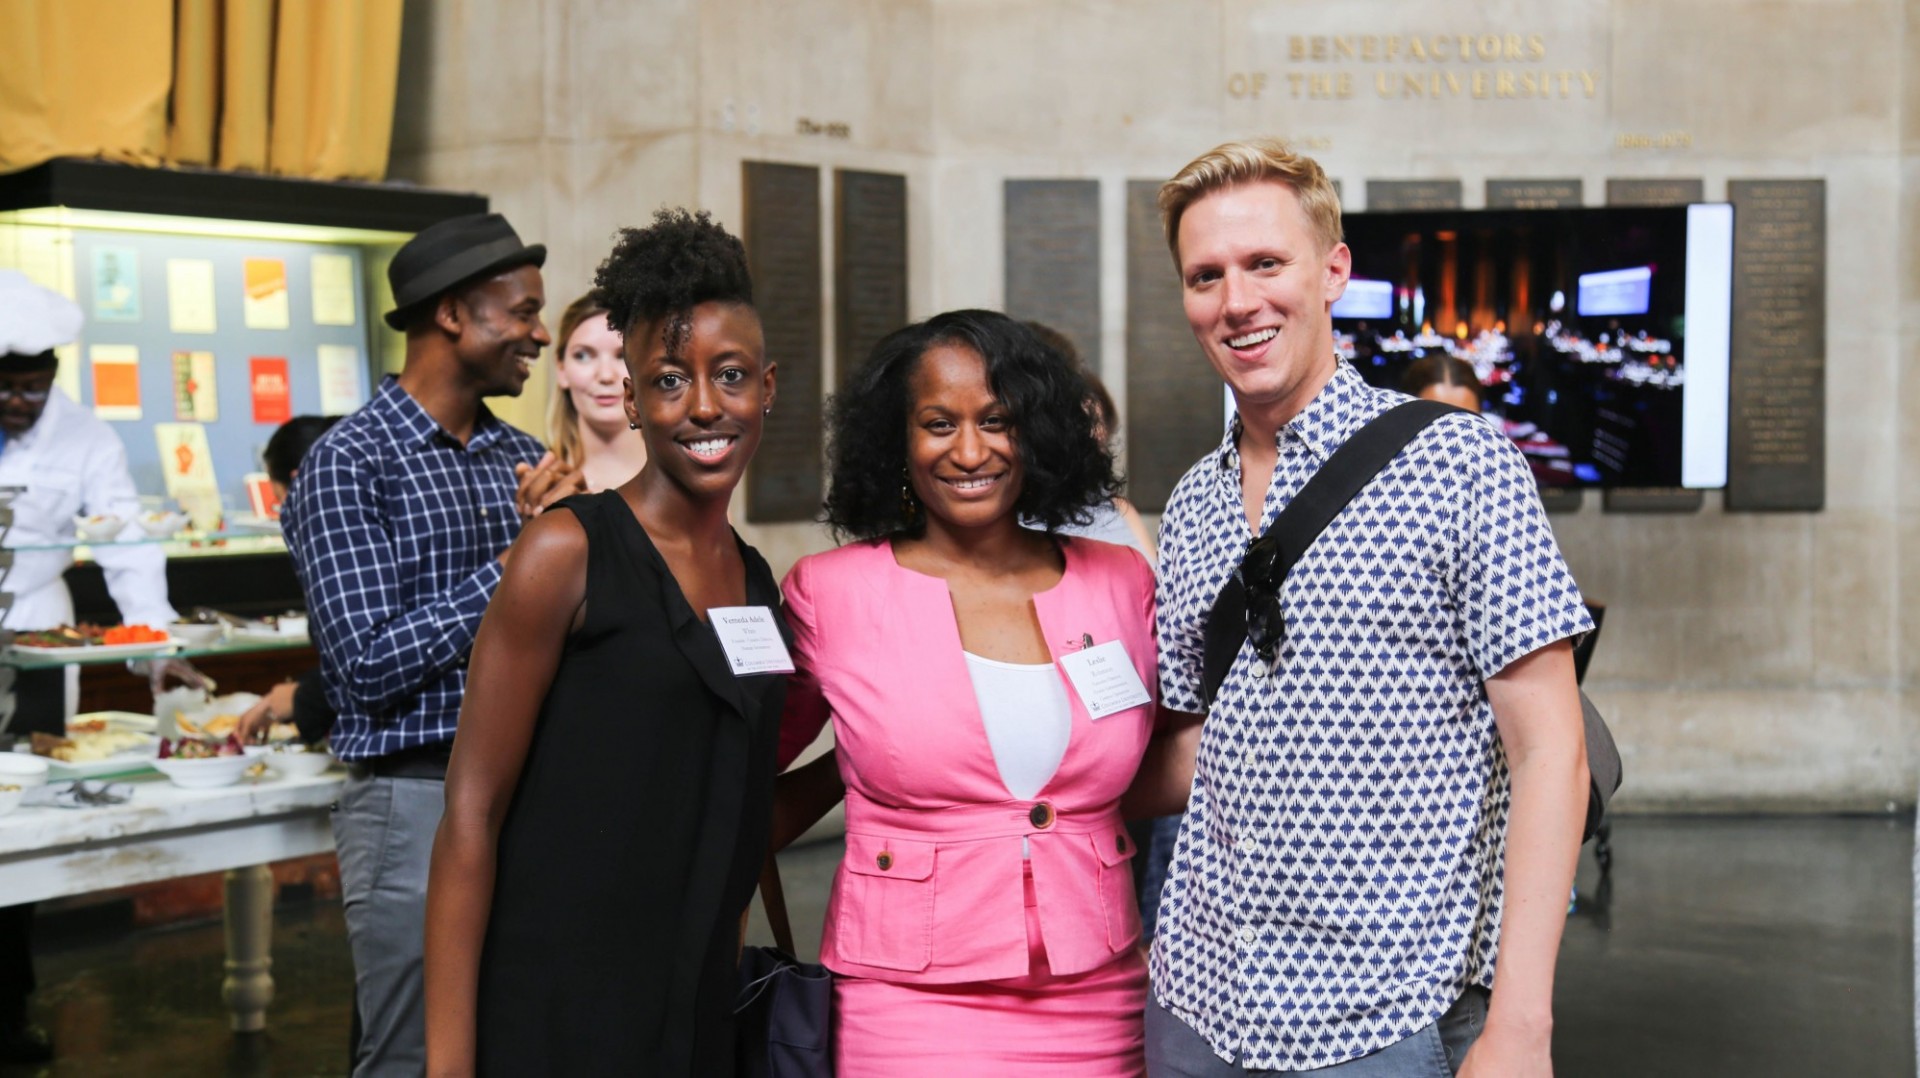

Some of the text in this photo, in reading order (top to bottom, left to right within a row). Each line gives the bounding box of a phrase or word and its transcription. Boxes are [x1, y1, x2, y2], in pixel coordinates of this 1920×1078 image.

[1288, 34, 1546, 62] BENEFACTORS
[1228, 70, 1600, 99] OF THE UNIVERSITY
